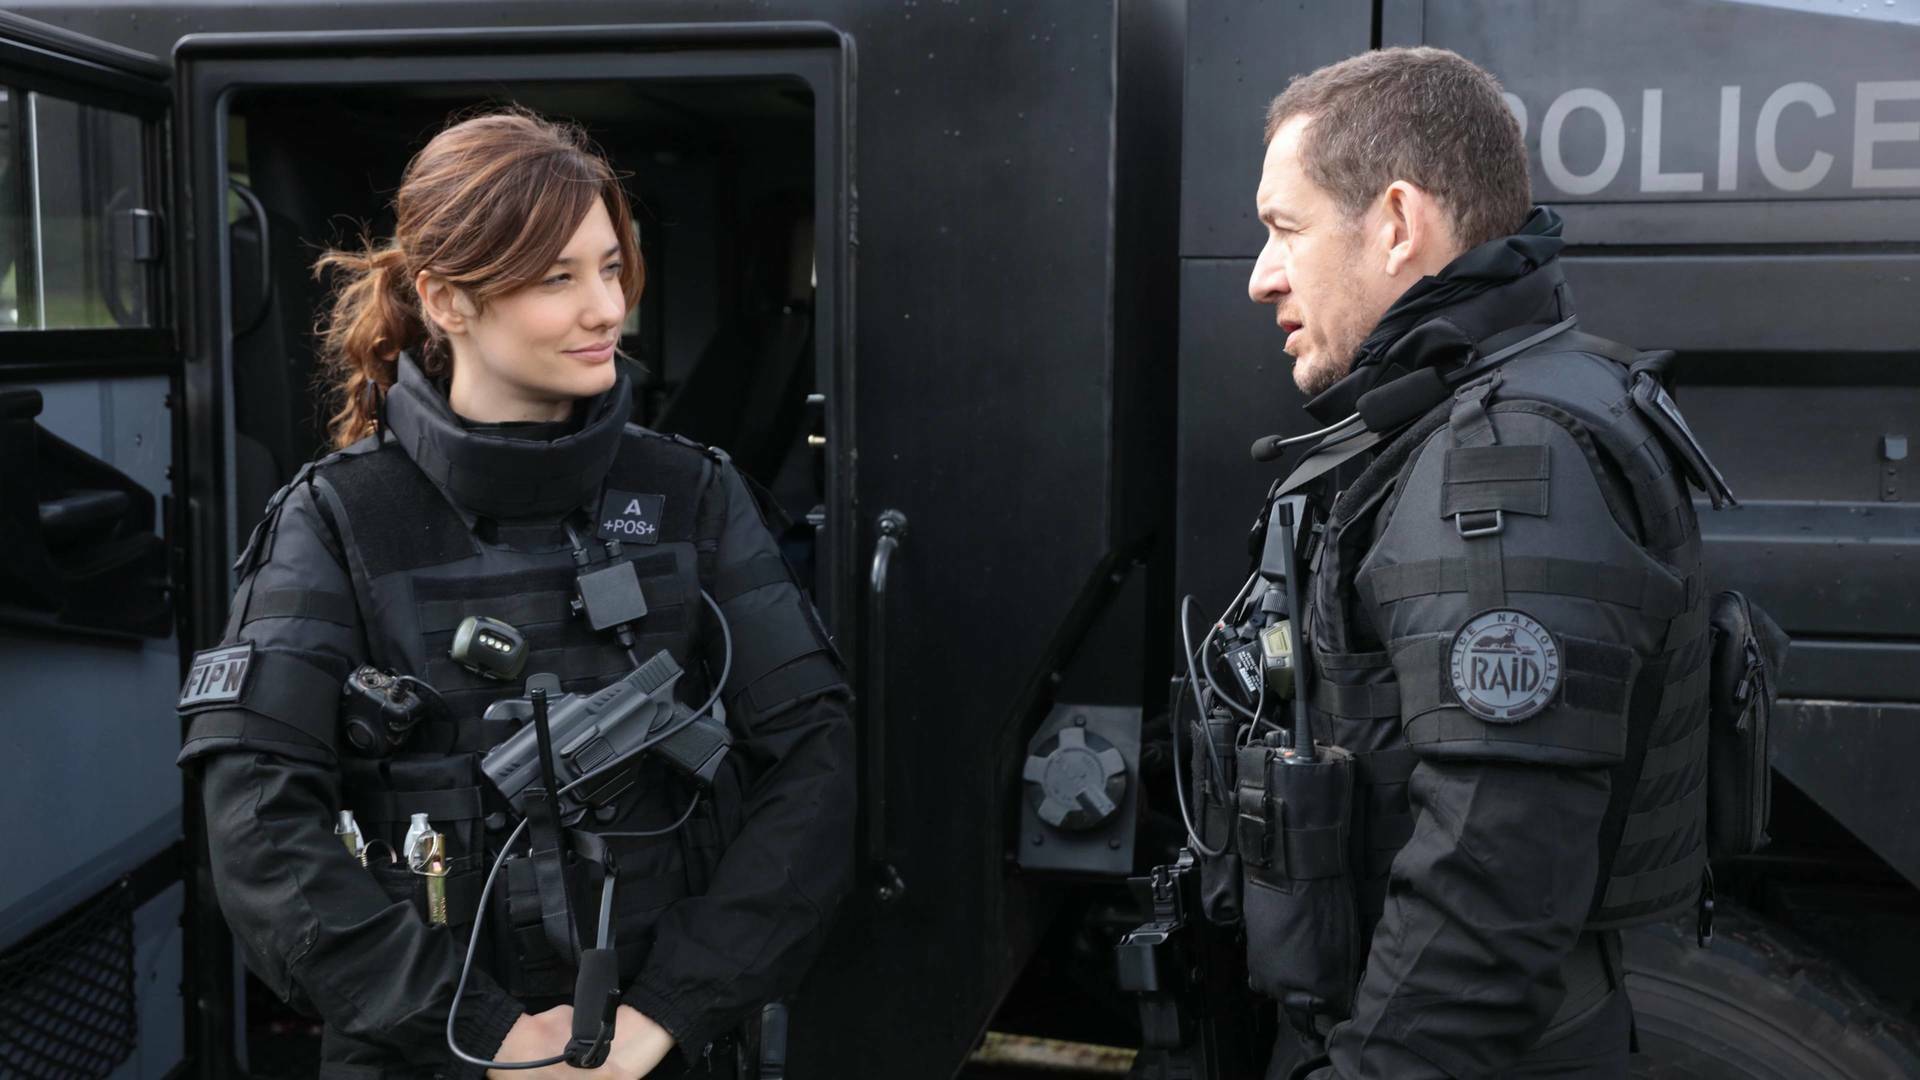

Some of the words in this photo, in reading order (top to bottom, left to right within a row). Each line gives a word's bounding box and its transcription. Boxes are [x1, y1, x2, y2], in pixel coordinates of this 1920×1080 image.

[623, 498, 641, 516] A
[1452, 625, 1477, 693] POLICE
[1497, 613, 1558, 697] NATIONALE
[183, 660, 247, 699] FIPN
